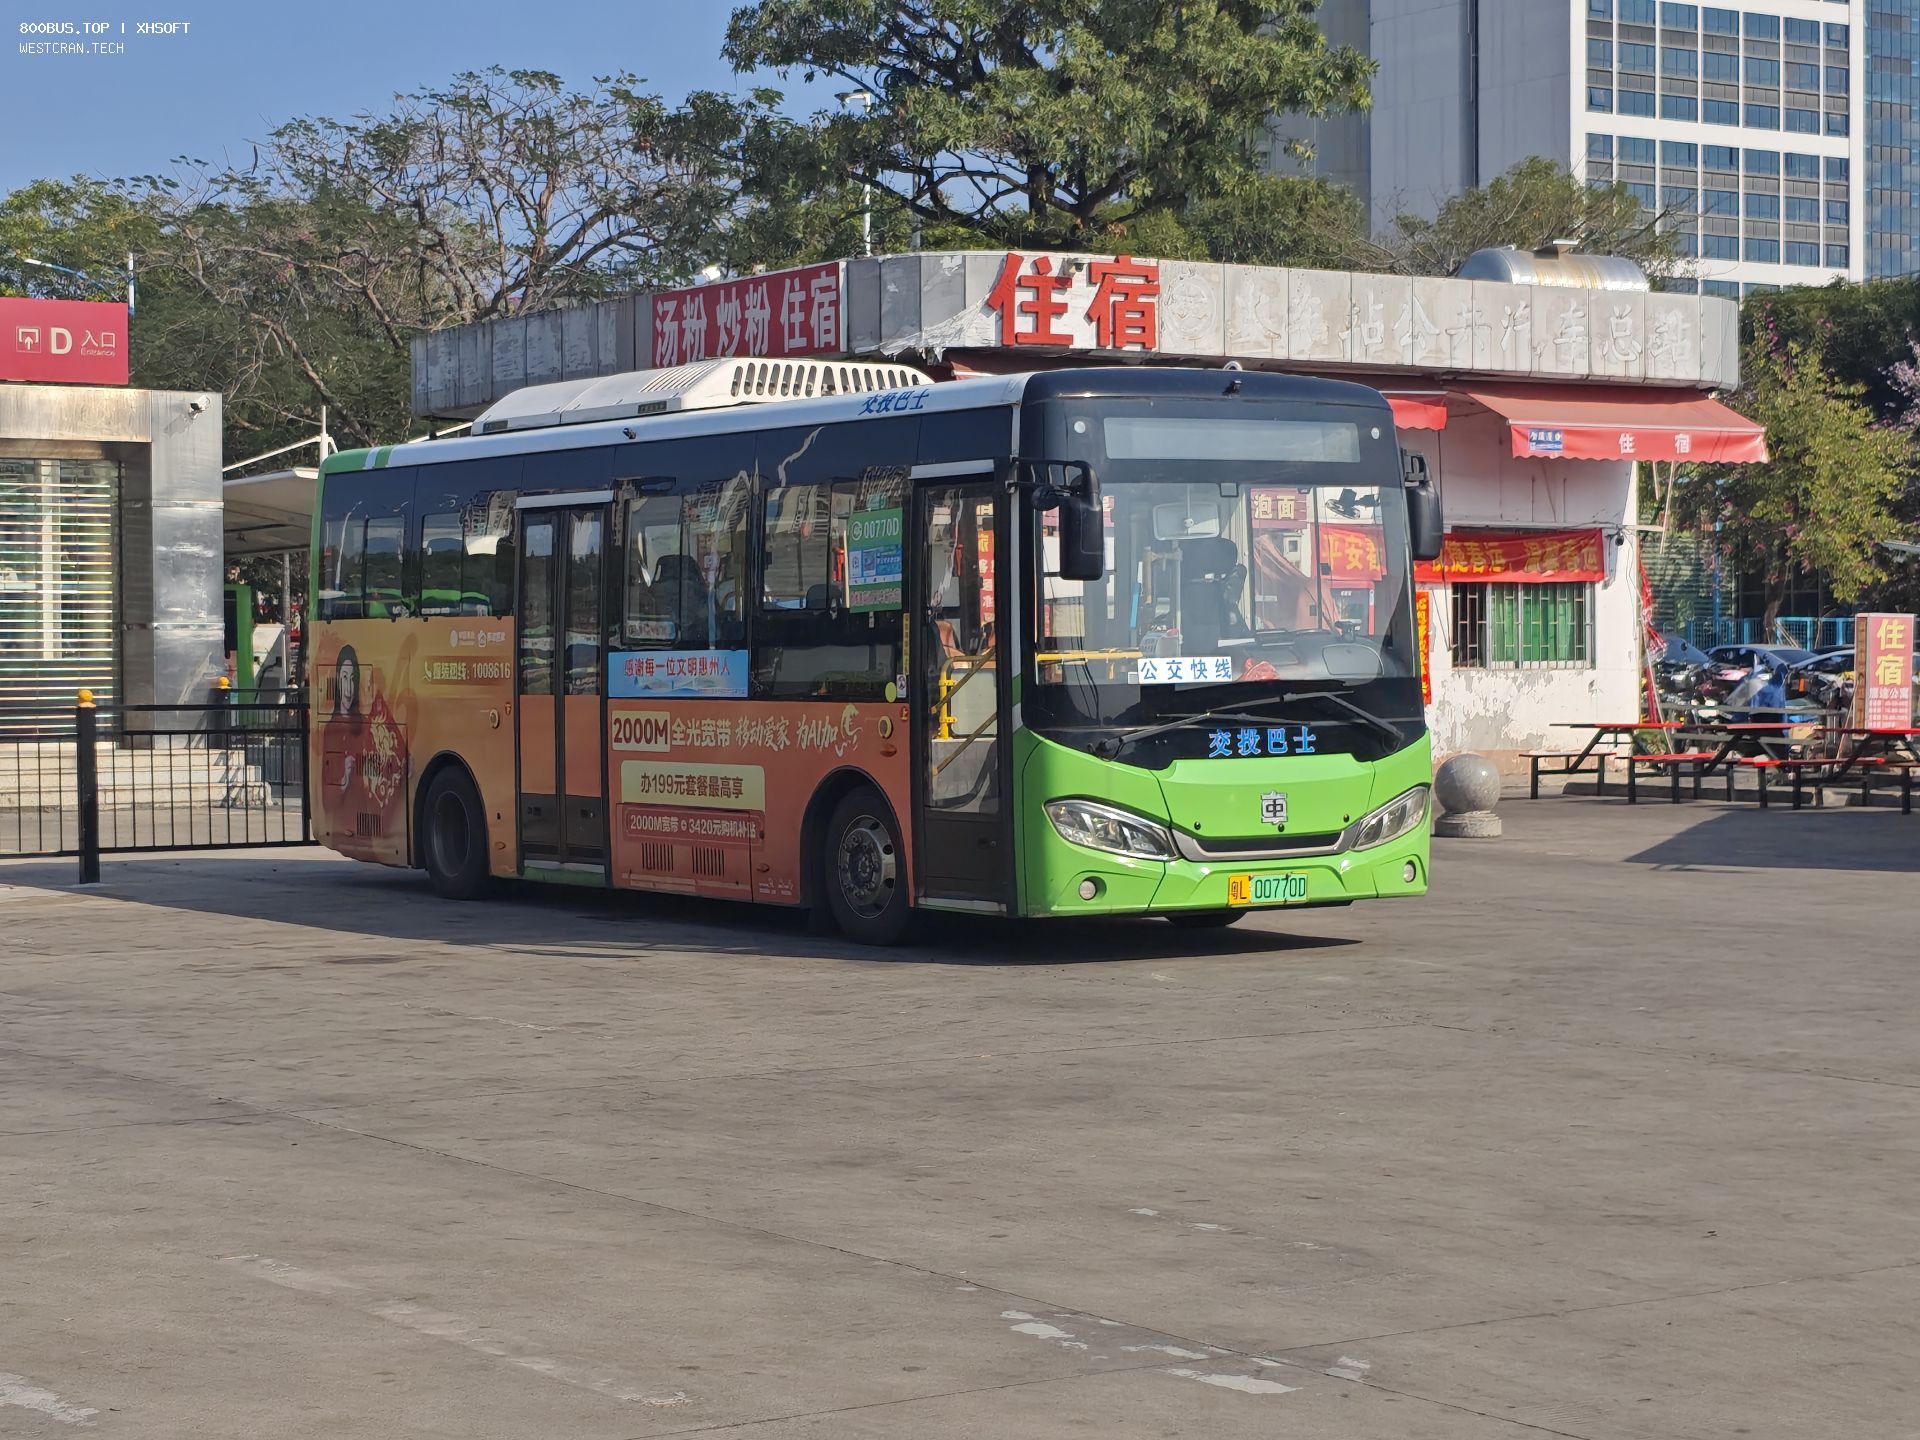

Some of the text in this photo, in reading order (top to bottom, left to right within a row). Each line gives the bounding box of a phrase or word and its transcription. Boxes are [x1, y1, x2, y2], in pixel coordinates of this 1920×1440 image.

[987, 252, 1161, 349] 住宿
[656, 270, 838, 368] 汤粉 炒粉 住宿
[50, 327, 116, 355] D 入口
[858, 388, 930, 416] 交投巴士
[1618, 432, 1692, 454] 住宿
[1254, 493, 1296, 520] 泡面
[864, 518, 900, 539] 00770D
[1875, 618, 1905, 686] 住宿
[624, 656, 730, 677] 感谢每一位文明惠州人
[1140, 658, 1231, 681] 公交快线
[613, 717, 668, 745] 2000M
[671, 717, 732, 748] 全光宽带
[735, 715, 790, 751] 移动爱家
[1208, 725, 1317, 758] 交投巴士
[640, 772, 744, 799] 办199元套餐最高享
[1255, 877, 1306, 899] 00770D
